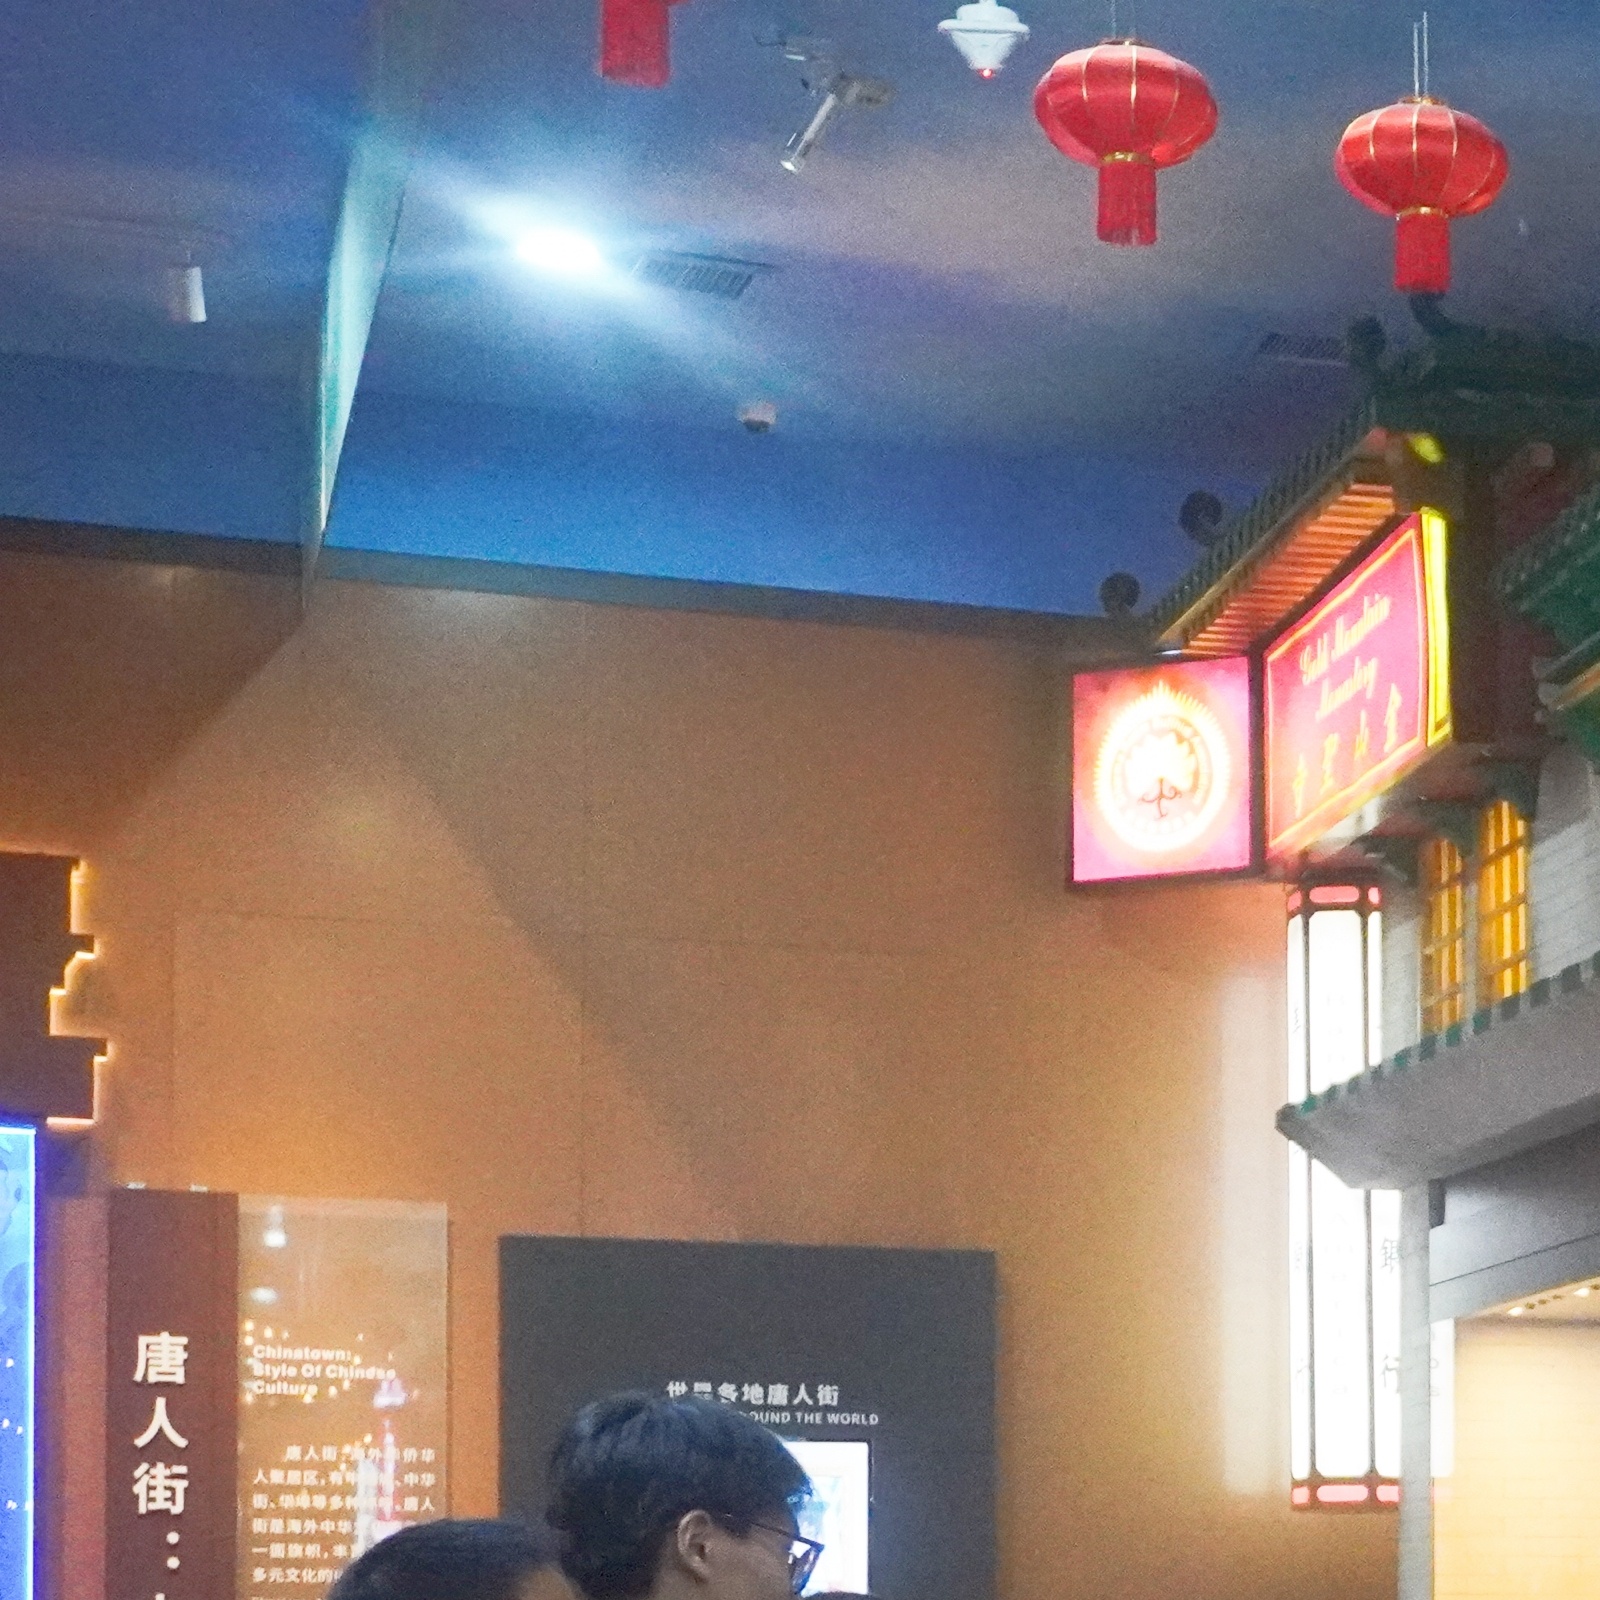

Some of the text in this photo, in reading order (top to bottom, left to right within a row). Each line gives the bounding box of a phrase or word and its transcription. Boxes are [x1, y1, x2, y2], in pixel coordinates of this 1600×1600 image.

[253, 1344, 351, 1361] Chinatown:
[253, 1363, 297, 1380] Style
[301, 1363, 321, 1378] Of
[253, 1381, 318, 1395] Culture
[749, 1411, 879, 1426] OUND THE WORLD
